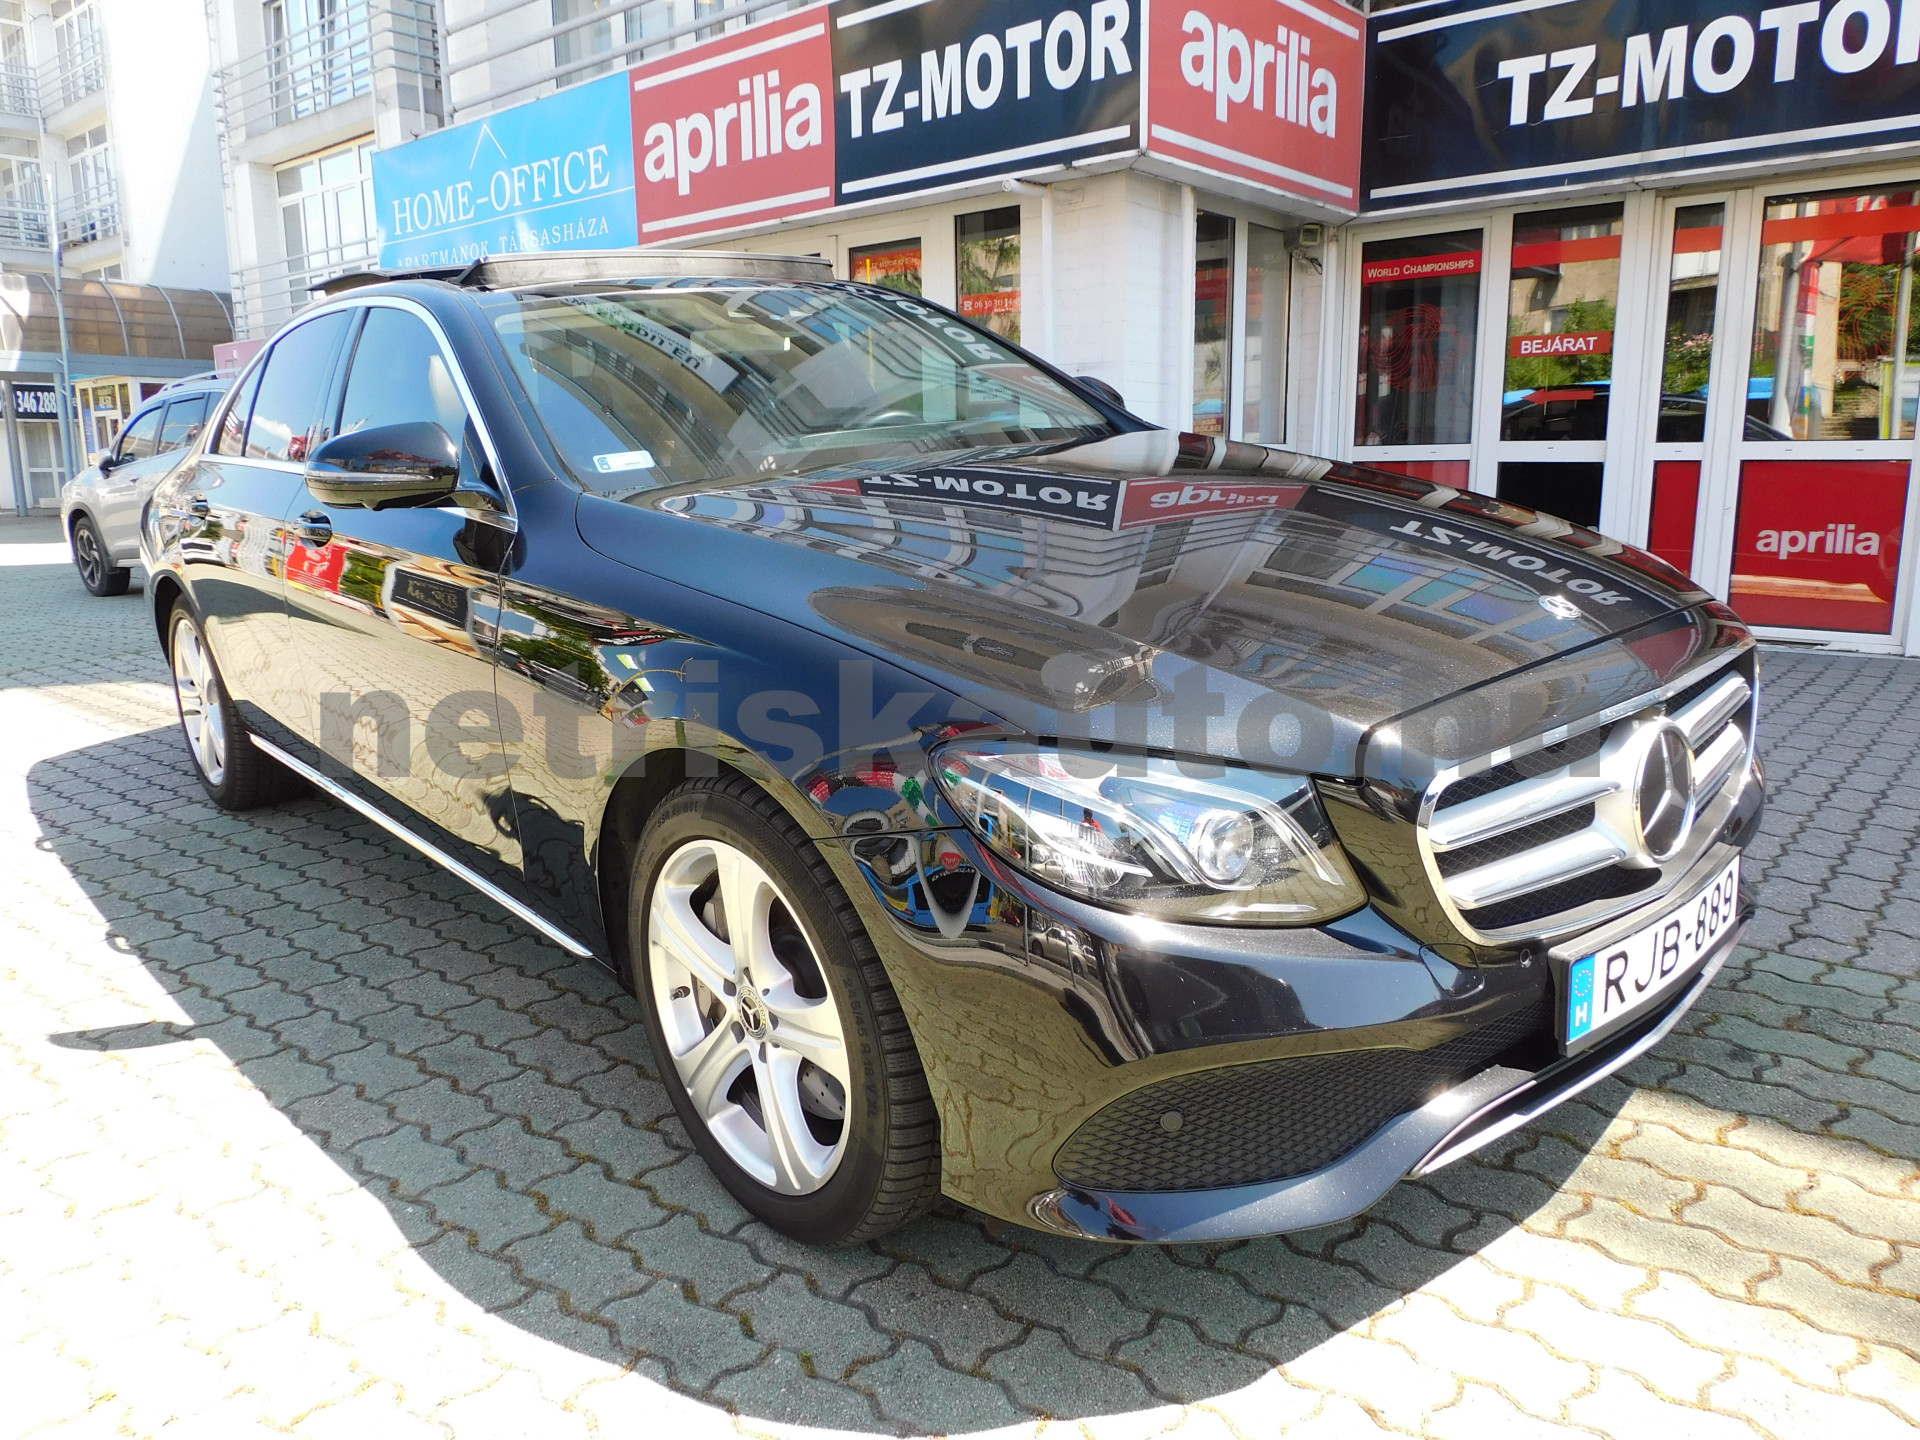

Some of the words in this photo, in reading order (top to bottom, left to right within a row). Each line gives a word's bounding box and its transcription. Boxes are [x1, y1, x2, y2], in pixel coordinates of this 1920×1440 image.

[840, 0, 1133, 138] TZ-MOTOR
[1180, 9, 1338, 139] aprilia
[643, 69, 823, 196] aprilia
[392, 144, 611, 236] HOME-OFFICE
[499, 215, 611, 253] TÁRSASHÁZA
[1521, 335, 1598, 355] BEJÁRAT
[16, 391, 37, 413] 346
[1756, 523, 1880, 560] aprilia
[1604, 870, 1734, 1014] RJB-889
[1575, 1001, 1588, 1028] H
